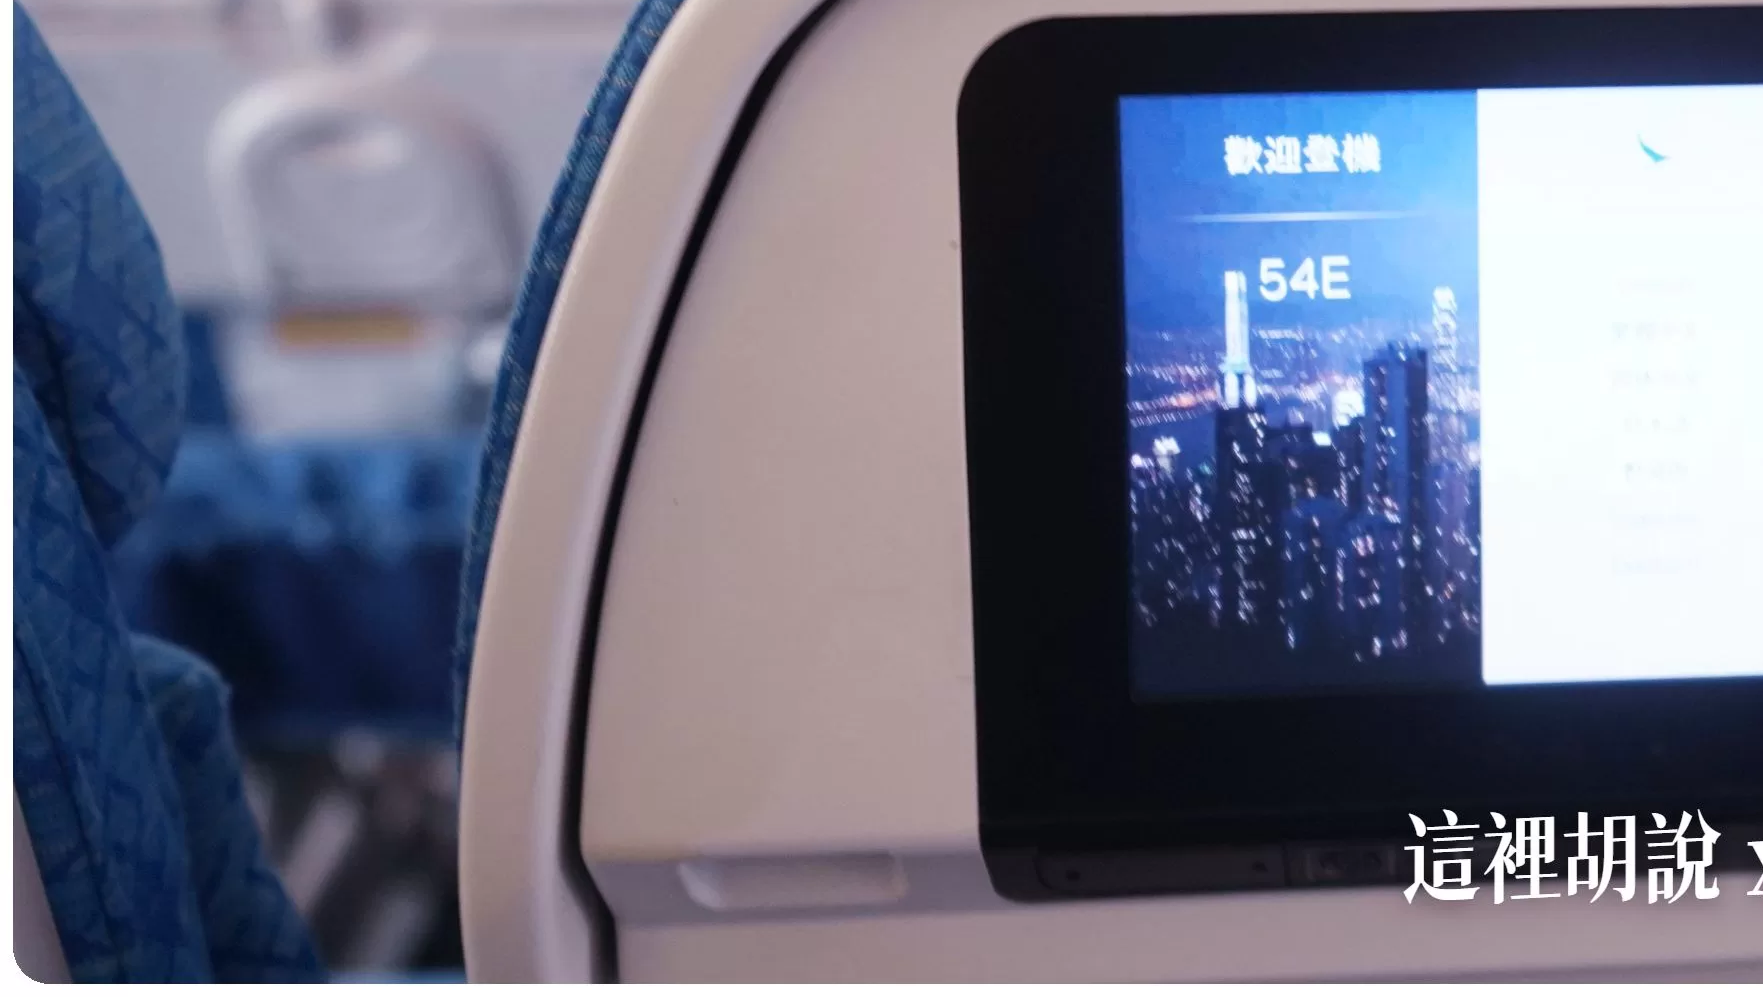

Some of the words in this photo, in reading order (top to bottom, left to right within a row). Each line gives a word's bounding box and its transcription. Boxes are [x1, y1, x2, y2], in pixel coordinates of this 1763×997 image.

[1223, 133, 1382, 176] 歡迎登機
[1258, 255, 1352, 302] 54E
